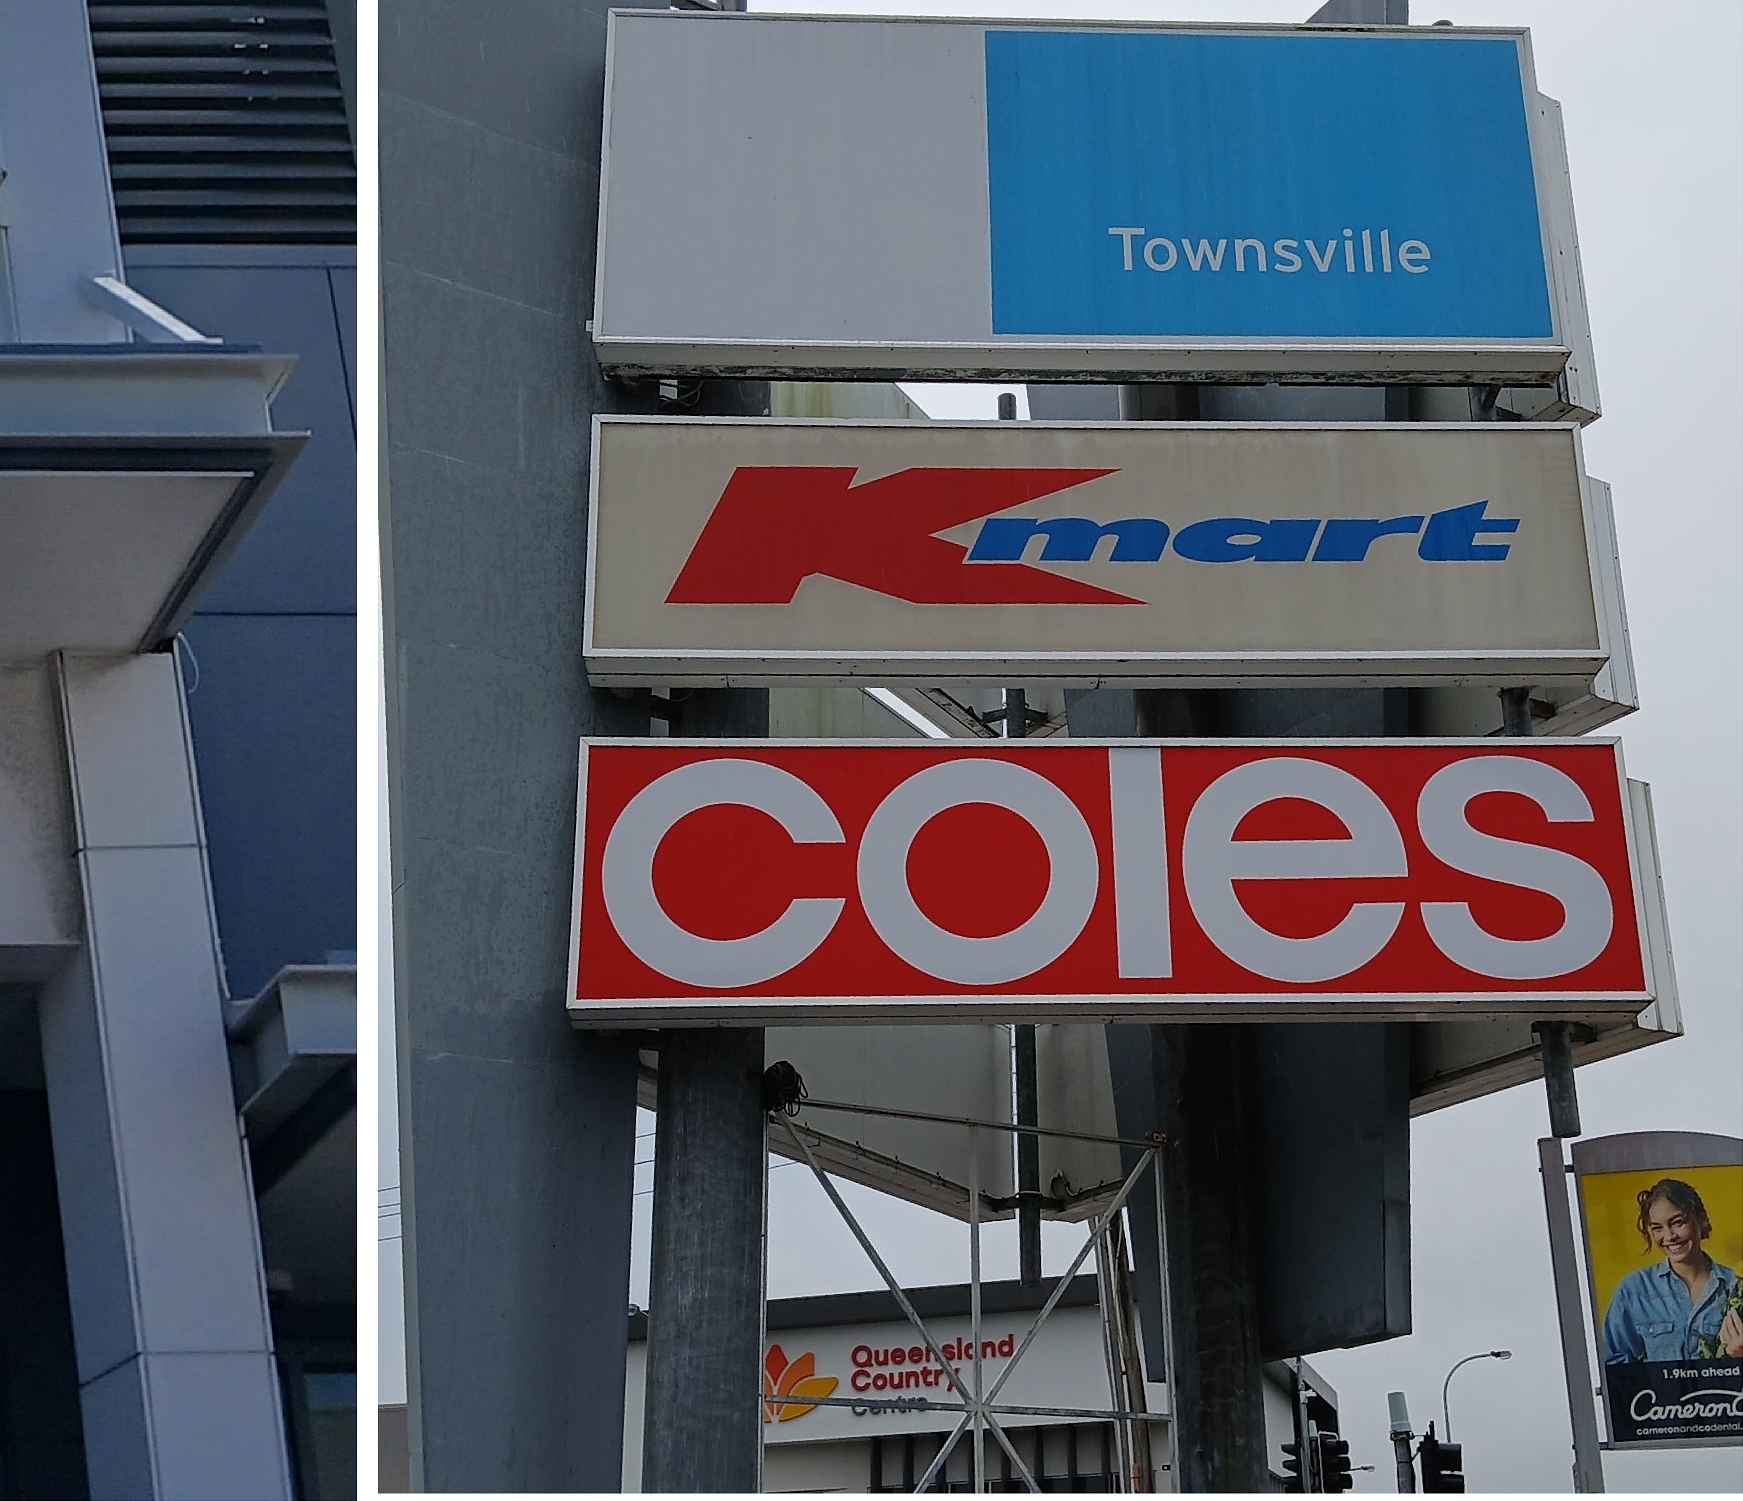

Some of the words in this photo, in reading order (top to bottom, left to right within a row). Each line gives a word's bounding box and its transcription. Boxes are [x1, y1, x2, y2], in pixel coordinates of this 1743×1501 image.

[1107, 226, 1432, 274] Townsville
[665, 465, 1521, 606] Kmart
[601, 748, 1614, 989] coles
[851, 1333, 1015, 1368] Queensland
[1662, 1368, 1699, 1379] 1.9km
[1701, 1365, 1741, 1377] ahead
